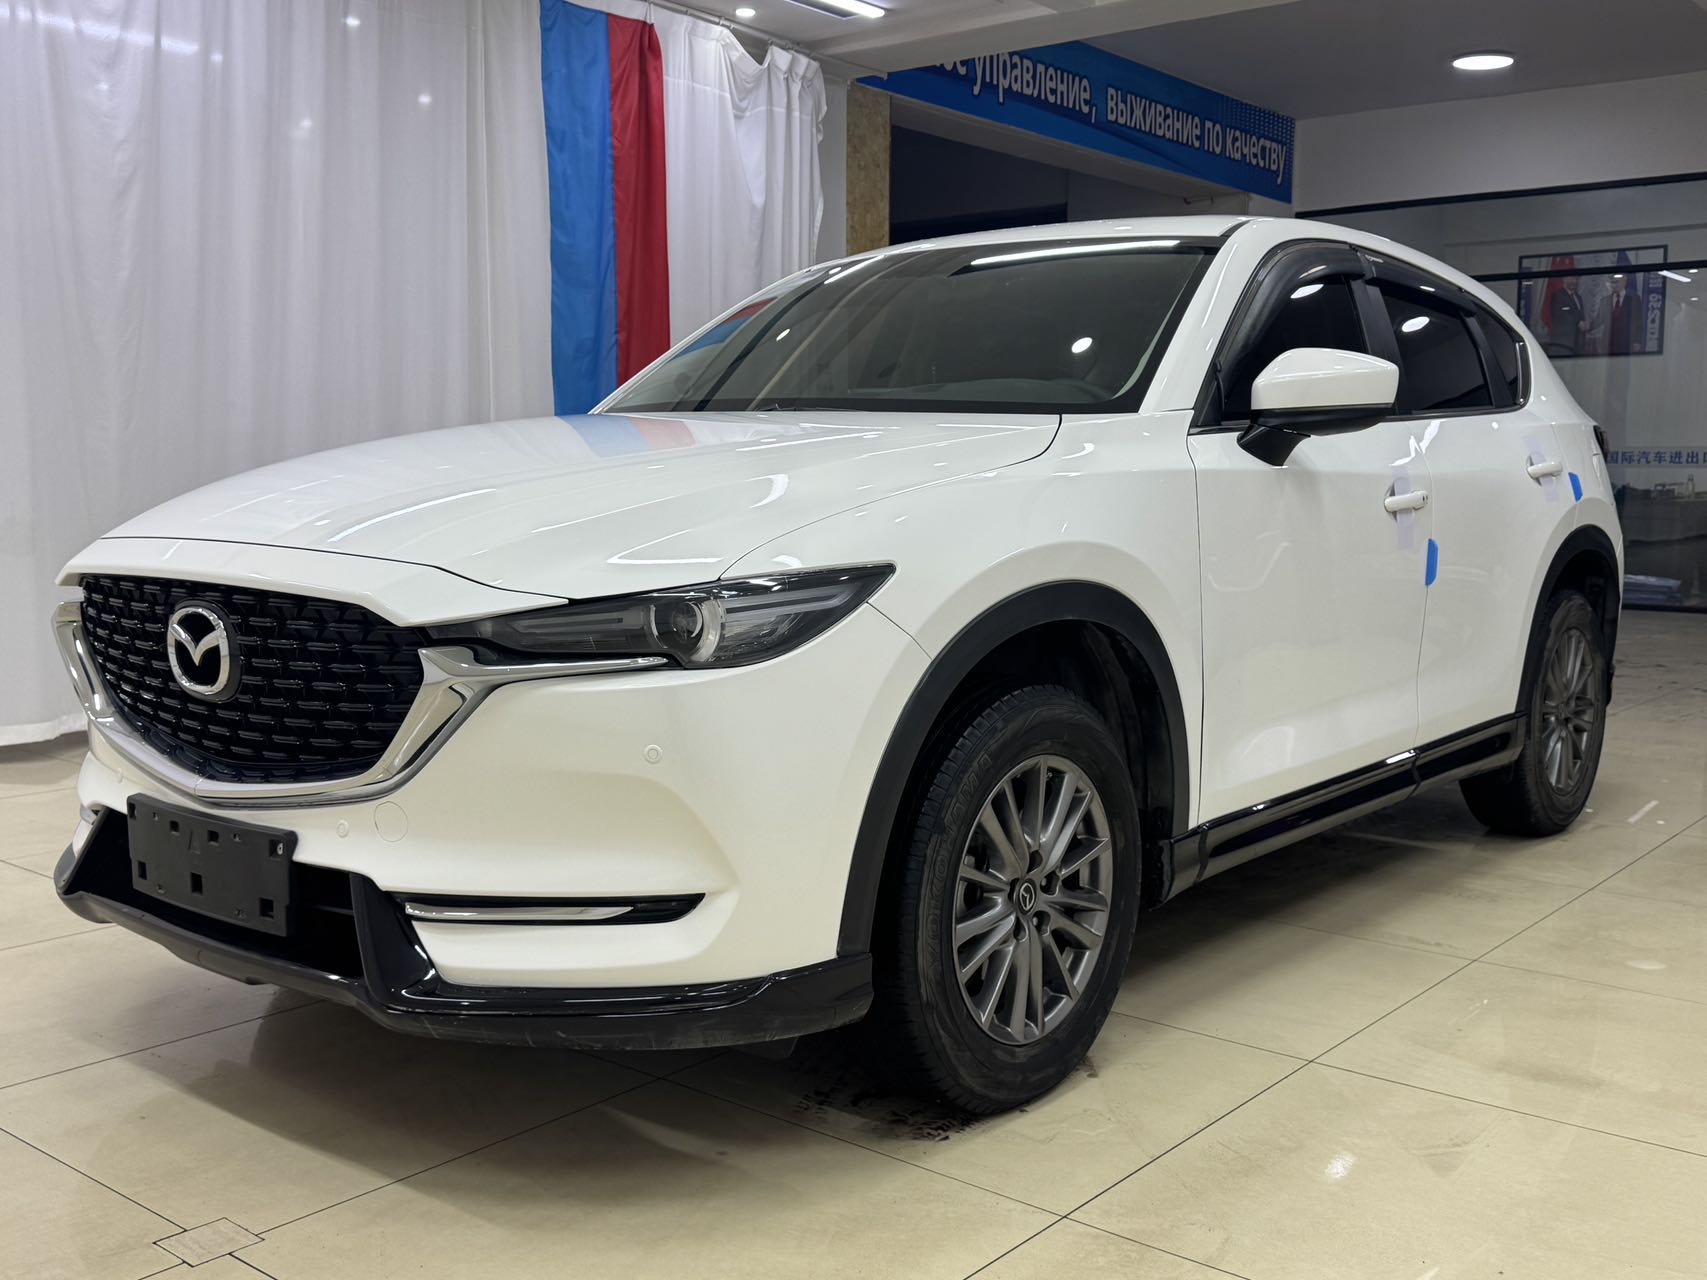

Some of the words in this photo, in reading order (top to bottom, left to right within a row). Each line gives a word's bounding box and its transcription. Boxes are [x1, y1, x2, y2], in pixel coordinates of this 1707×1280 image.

[973, 52, 1097, 124] управление,
[1107, 87, 1201, 149] выживание
[1205, 121, 1222, 154] по
[1226, 128, 1287, 185] качеству
